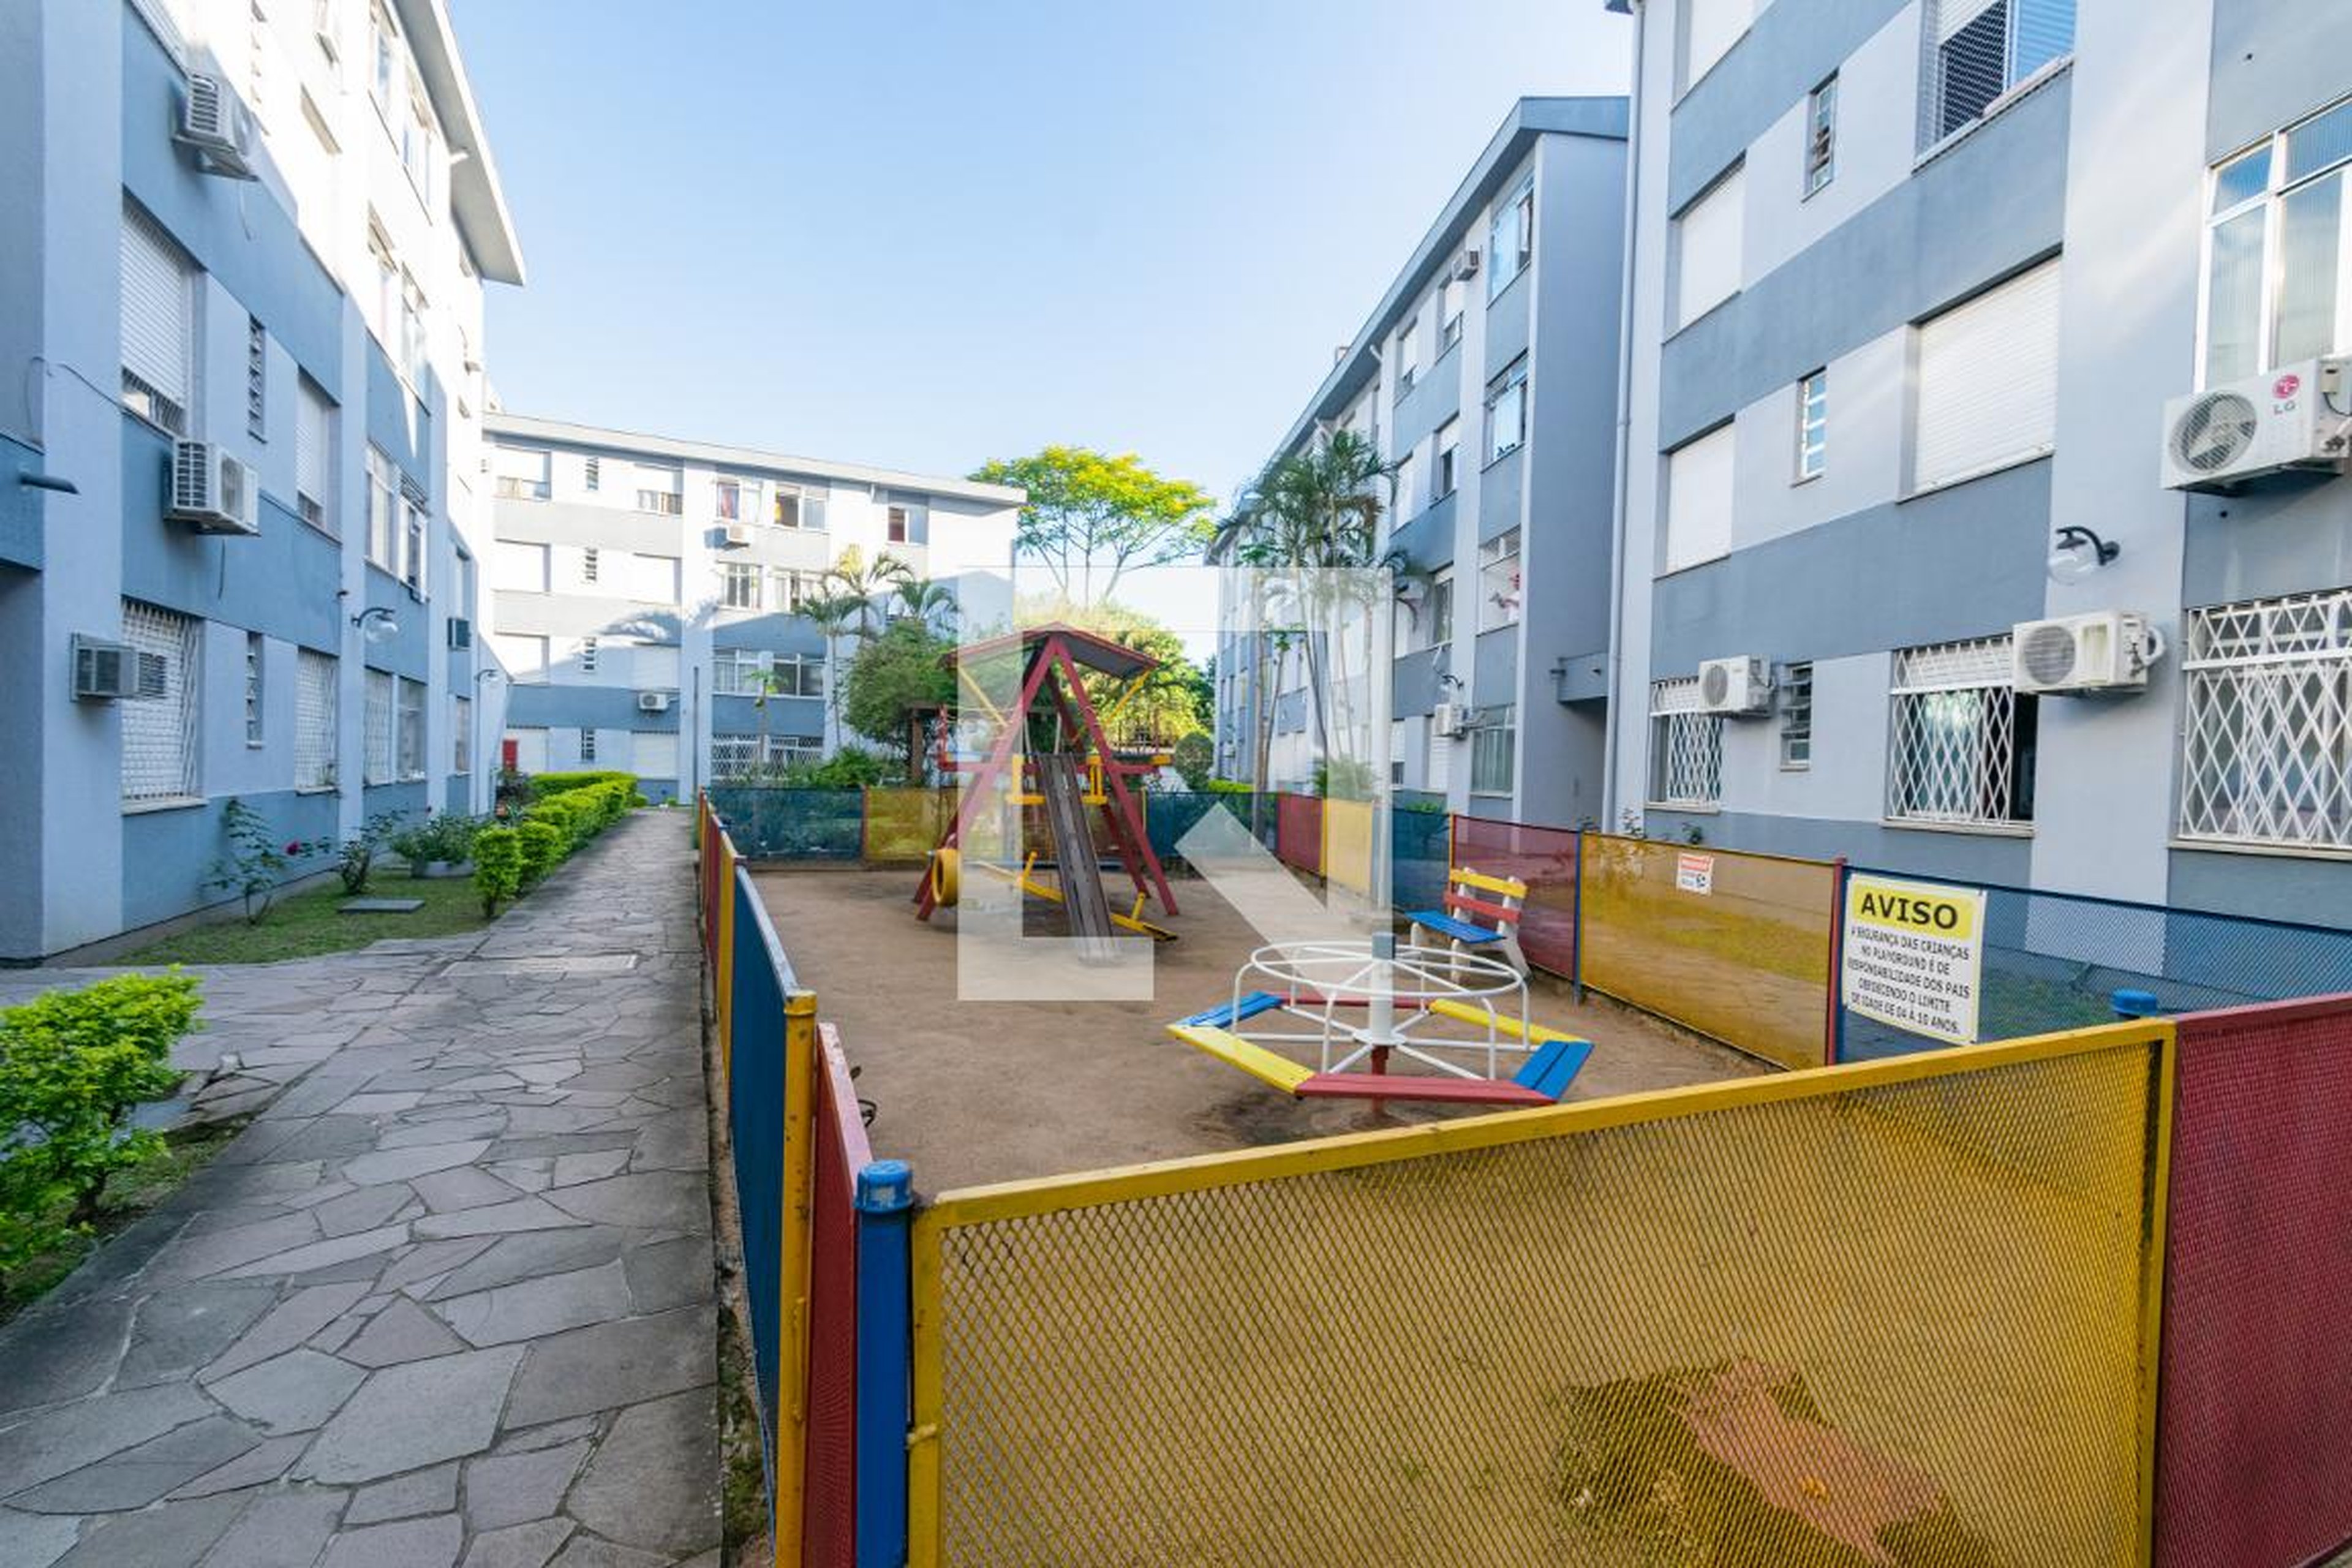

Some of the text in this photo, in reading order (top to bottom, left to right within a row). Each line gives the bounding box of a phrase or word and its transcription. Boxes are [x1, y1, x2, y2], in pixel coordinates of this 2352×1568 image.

[2273, 400, 2296, 415] LG
[1861, 893, 1958, 929] AVISO
[1857, 927, 1898, 948] SEGURANÇA
[1901, 936, 1918, 950] DAS
[1921, 940, 1969, 962] CRIANÇAS
[1861, 944, 1871, 956] NO
[1873, 947, 1926, 971] PLAYGROUND
[1937, 961, 1950, 976] DE
[1847, 957, 1969, 999] RESPONSABILIDADE DOS PAIS
[1858, 977, 1950, 1013] OBEDECENDO O LIMITE
[1851, 991, 1860, 1004] DE
[1861, 995, 1882, 1011] IDADE
[1885, 1002, 1894, 1016] DE
